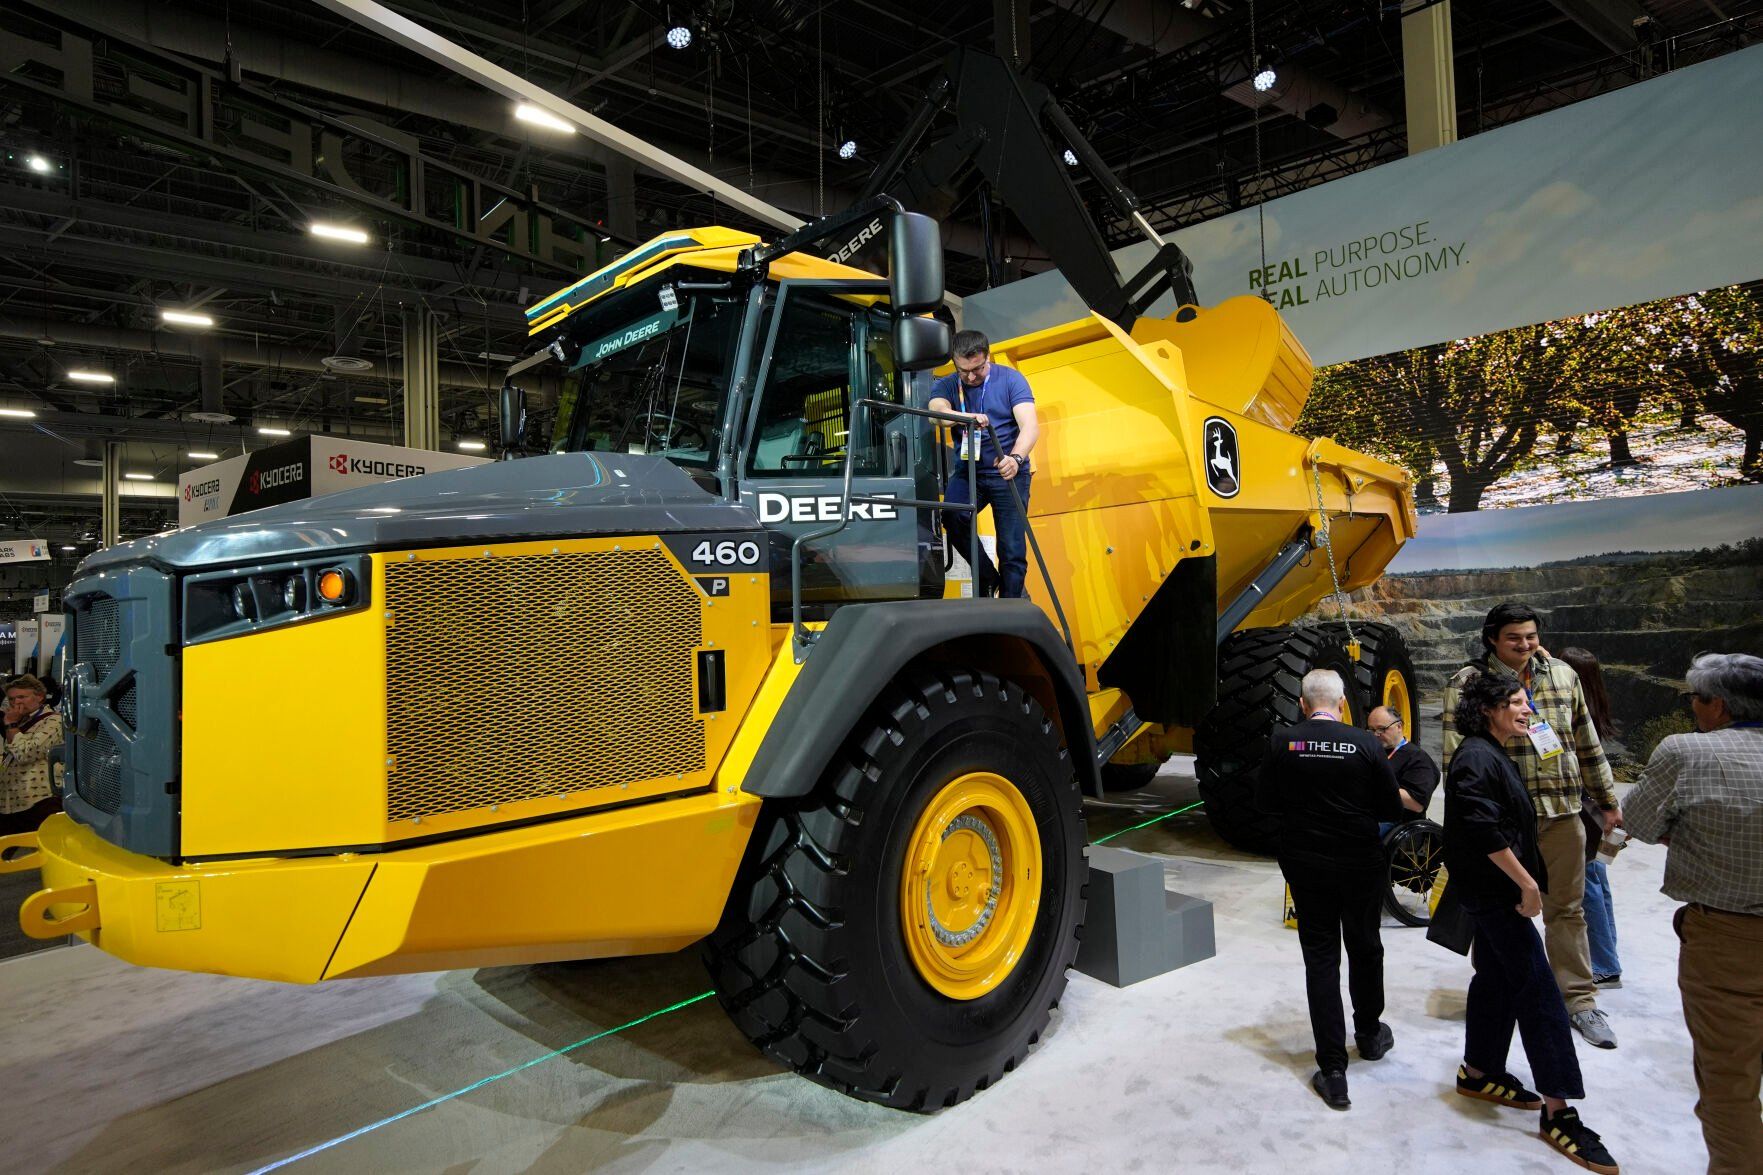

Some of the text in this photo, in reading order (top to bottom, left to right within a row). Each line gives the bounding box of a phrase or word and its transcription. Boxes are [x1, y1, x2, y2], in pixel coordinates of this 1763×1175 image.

[1248, 221, 1437, 290] REAL PURPOSE.
[1266, 242, 1471, 311] EAL AUTONOMY.
[596, 320, 660, 358] JOHN DEERE
[758, 493, 898, 523] DEERE
[691, 541, 760, 565] 460
[712, 579, 727, 595] P
[1307, 741, 1357, 754] THE LED
